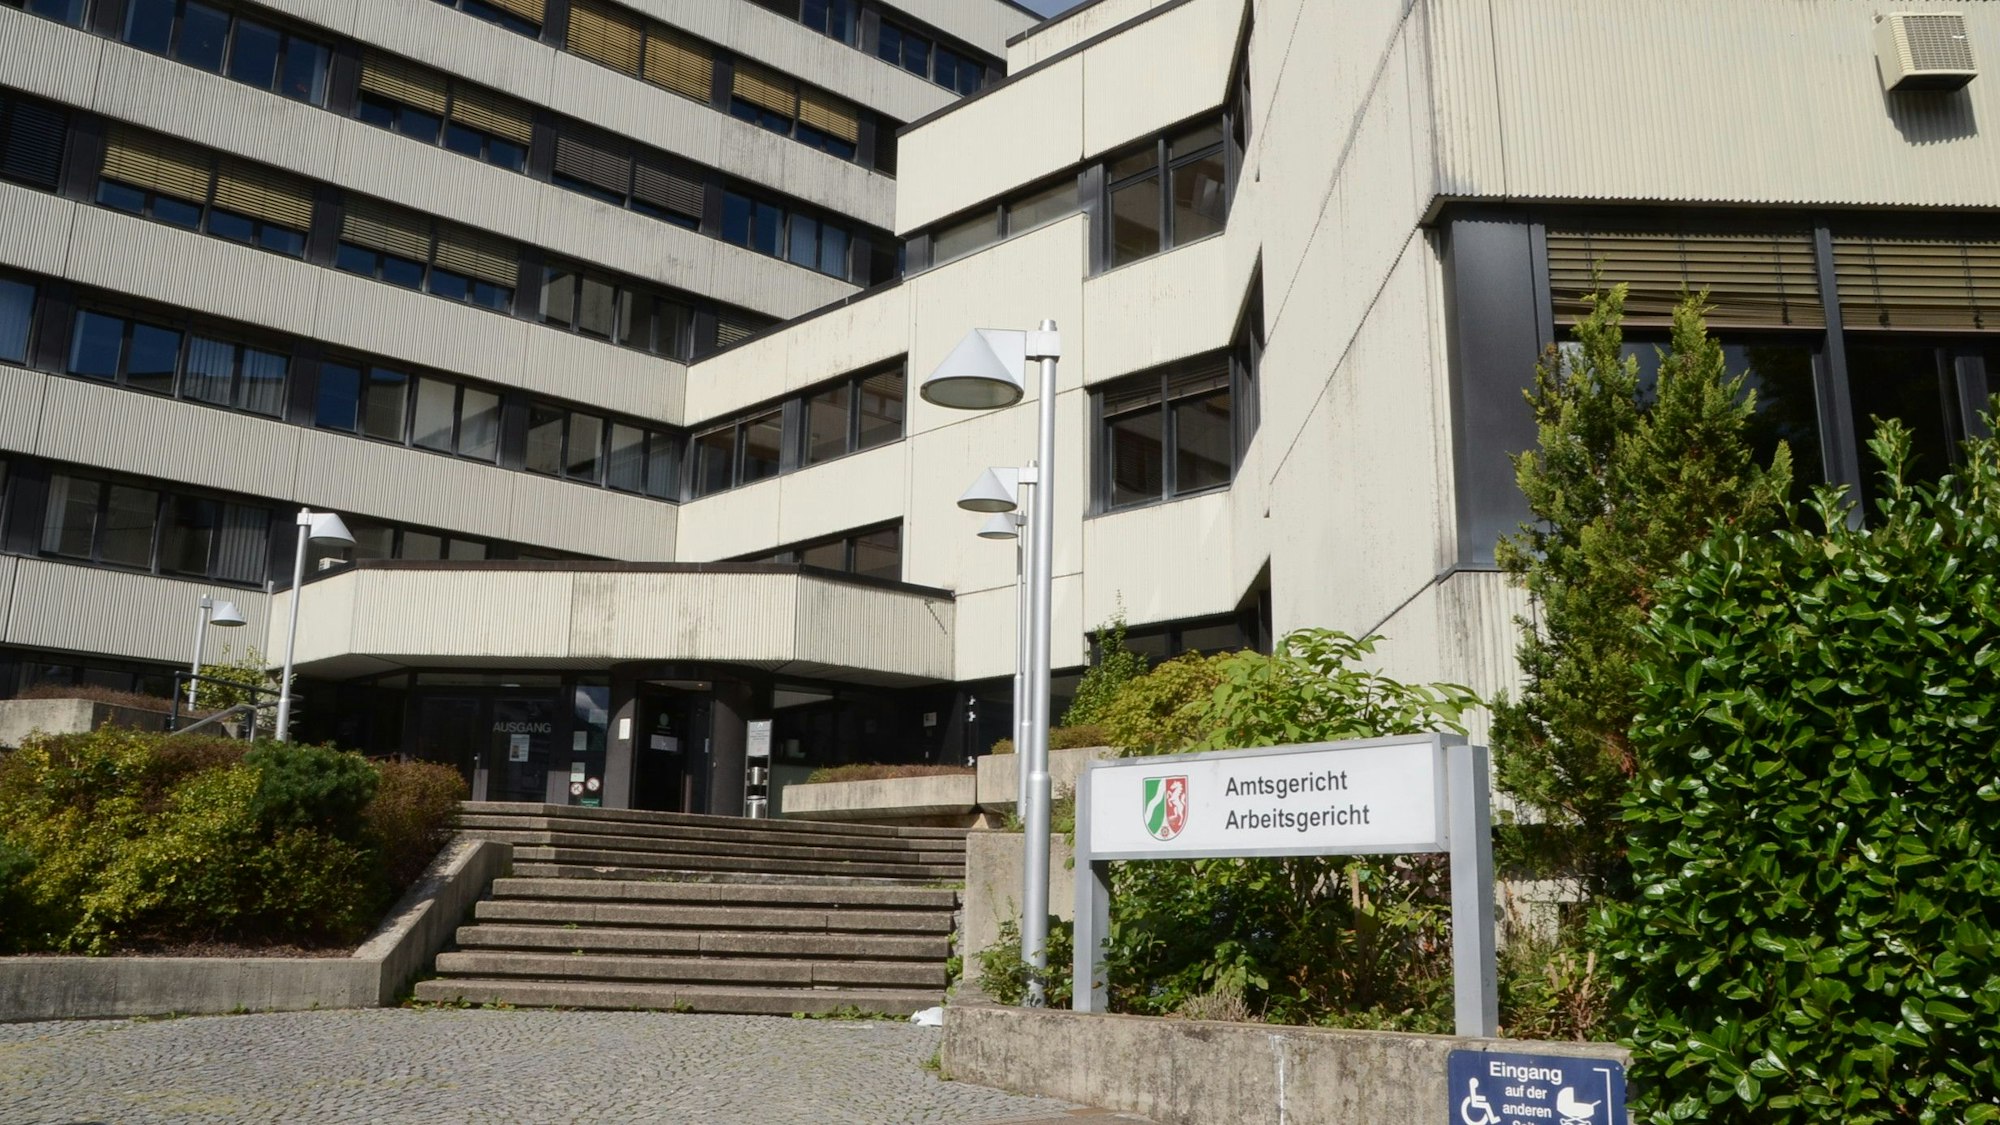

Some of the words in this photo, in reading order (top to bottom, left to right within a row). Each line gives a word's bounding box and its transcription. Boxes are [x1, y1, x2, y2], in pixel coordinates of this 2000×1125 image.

[492, 721, 552, 733] AUSGANG
[1225, 770, 1348, 799] Amtsgericht
[1225, 804, 1370, 832] Arbeitsgericht
[1489, 1061, 1562, 1085] Eingang
[1505, 1085, 1525, 1097] auf
[1526, 1086, 1548, 1100] der
[1502, 1102, 1552, 1119] anderen
